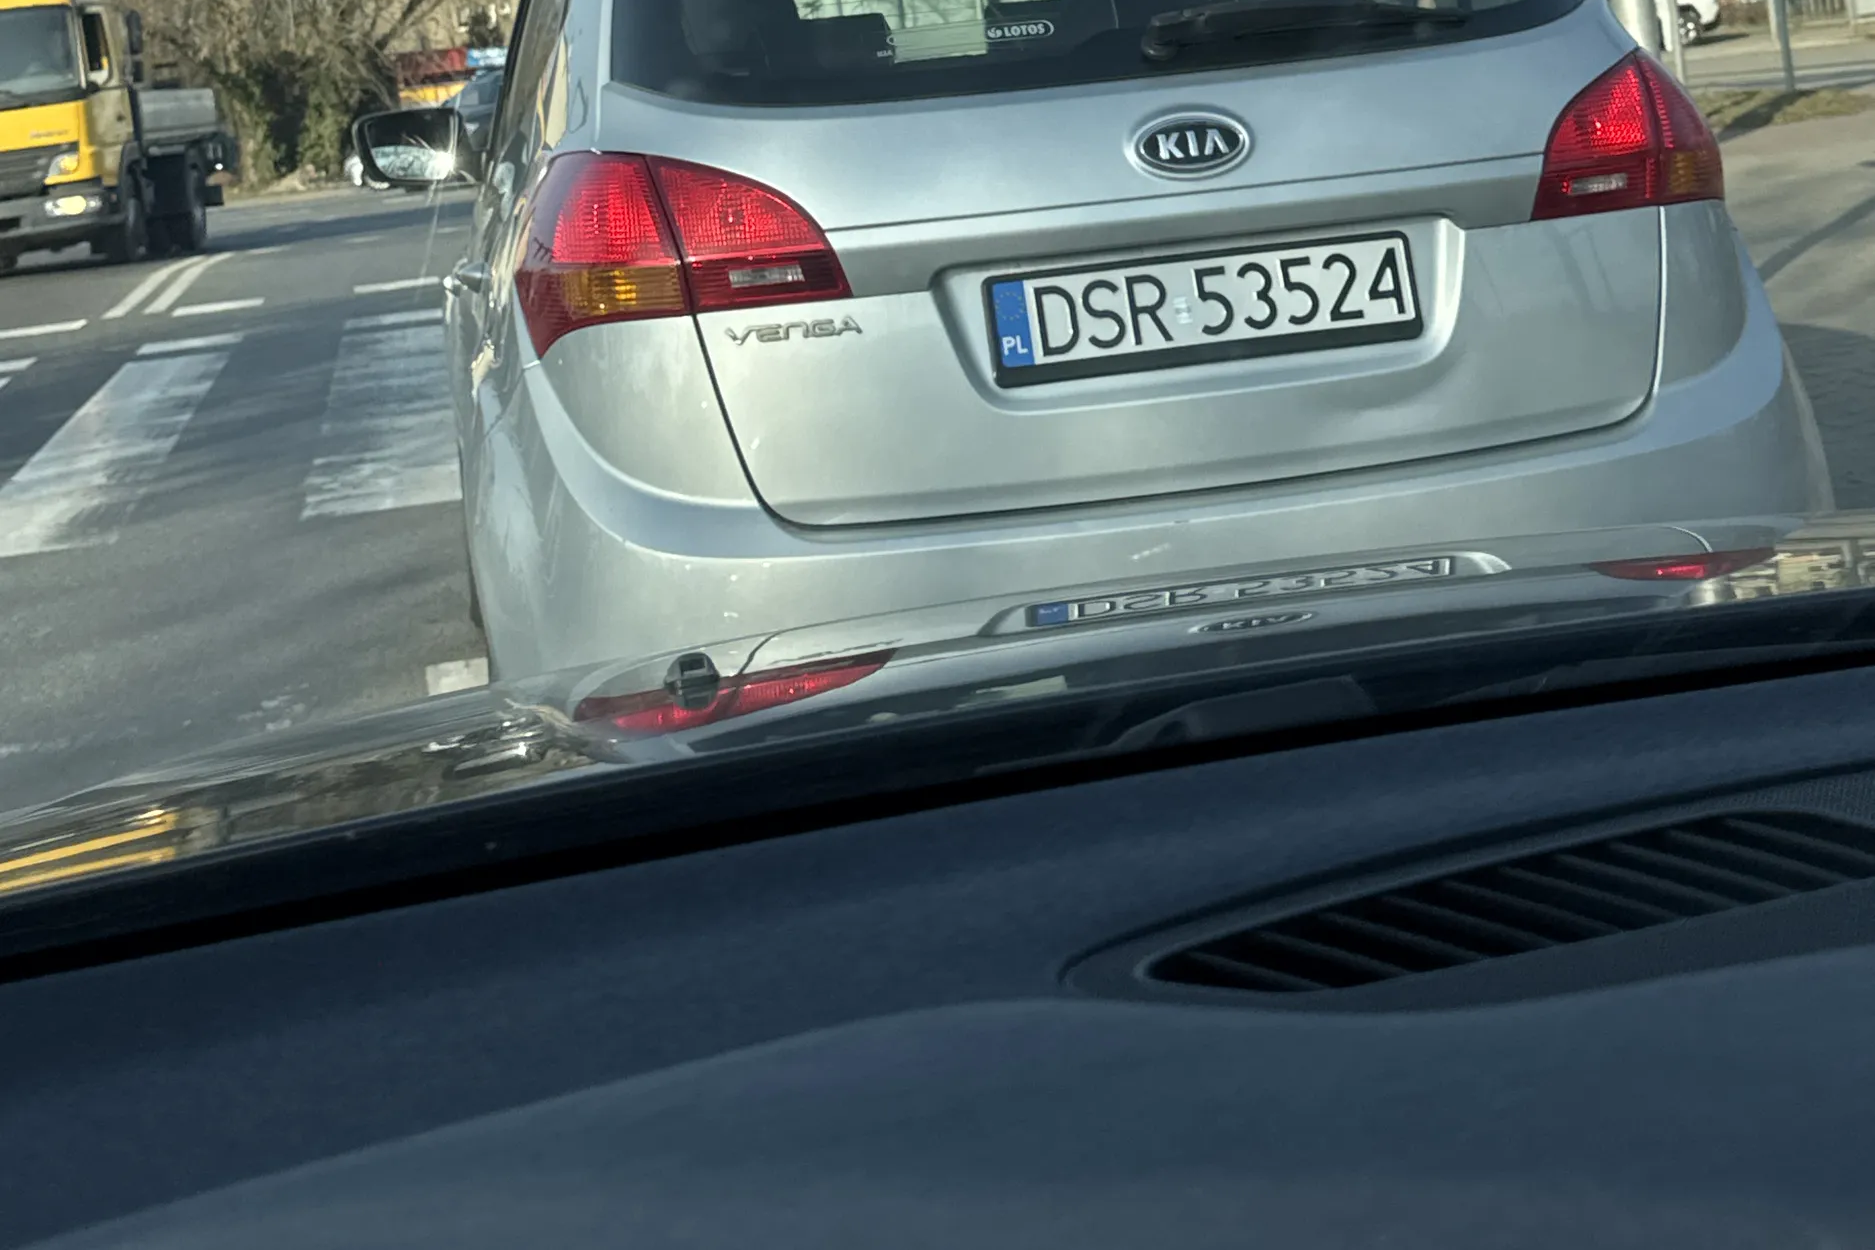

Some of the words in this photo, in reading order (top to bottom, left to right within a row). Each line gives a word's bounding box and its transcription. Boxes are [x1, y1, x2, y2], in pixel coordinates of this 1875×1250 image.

[1003, 23, 1046, 37] LOTOS
[1156, 128, 1230, 160] KIA
[1033, 273, 1174, 357] DSR
[1194, 247, 1406, 337] 53524
[724, 315, 863, 346] VENGA
[1002, 335, 1029, 356] PL
